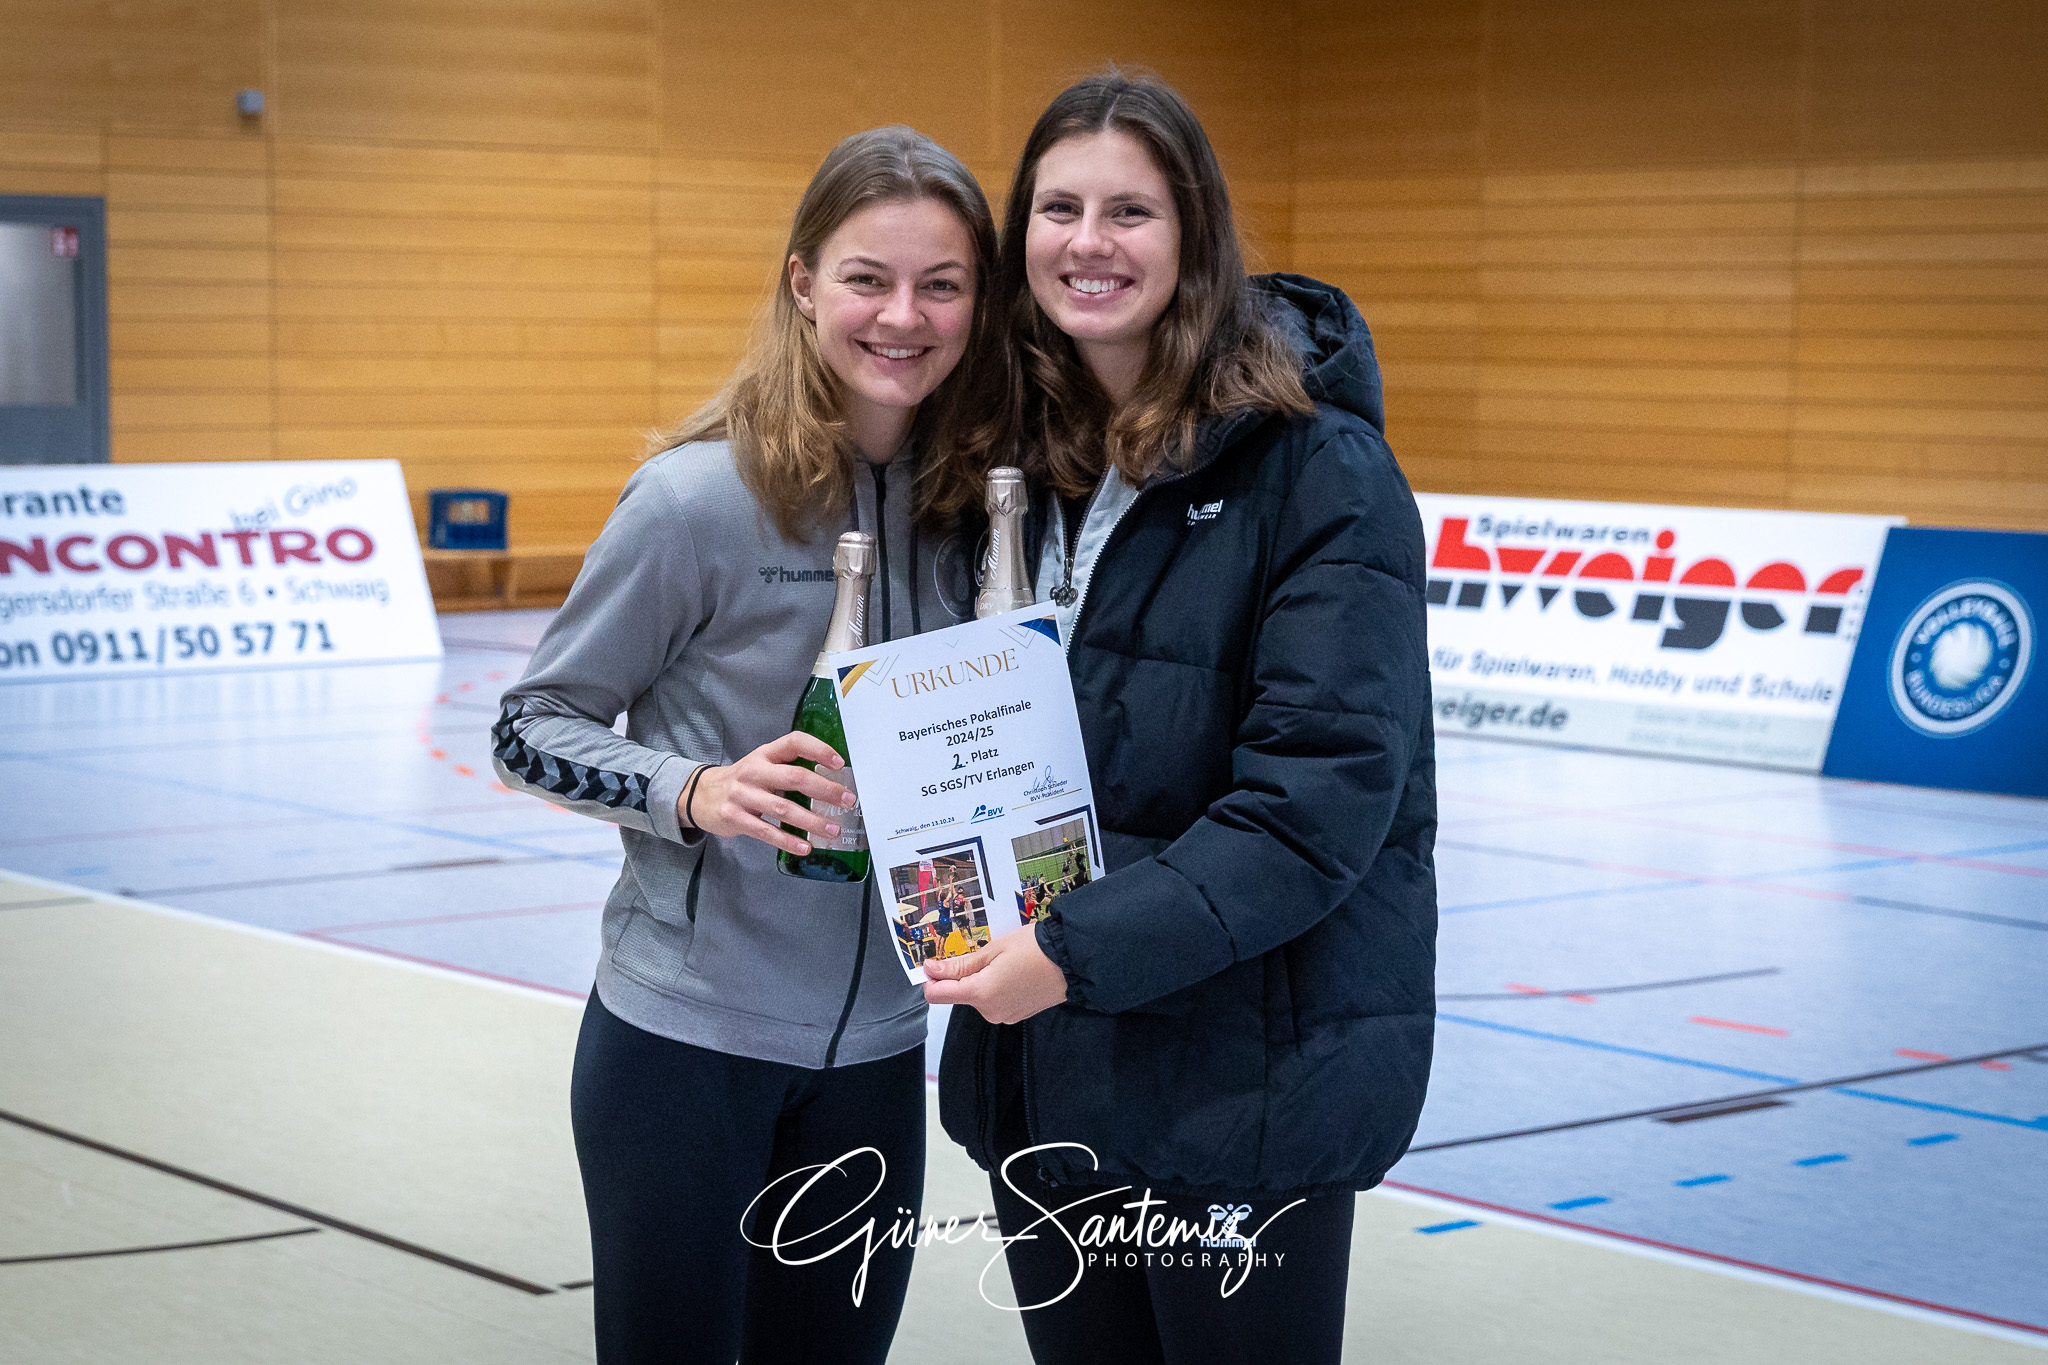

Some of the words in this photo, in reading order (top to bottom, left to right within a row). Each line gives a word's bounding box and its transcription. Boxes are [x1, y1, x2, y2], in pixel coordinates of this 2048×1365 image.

[284, 475, 358, 517] Gino
[1187, 499, 1223, 521] humel
[1475, 512, 1651, 546] Spielwaren
[987, 528, 1001, 581] Mumm
[144, 578, 231, 609] Straße
[238, 578, 257, 603] 6
[287, 574, 391, 606] Schwaig
[780, 566, 836, 583] humme
[848, 593, 865, 648] Mumm
[979, 601, 993, 611] DRY
[51, 625, 220, 669] 0911/50
[232, 622, 276, 654] 57
[291, 620, 336, 652] 71
[892, 648, 1020, 699] URKUNDE
[1609, 662, 1685, 698] Hobby
[1693, 672, 1742, 699] und
[1746, 673, 1835, 705] Schule
[898, 716, 969, 743] Bayerisches
[970, 699, 1033, 726] Pokalfinale
[945, 726, 995, 748] 2024/25
[971, 748, 999, 763] Platz
[921, 784, 938, 798] SG
[940, 772, 984, 793] SGS/TV
[986, 759, 1036, 782] Erlangen
[919, 822, 931, 830] den
[931, 816, 955, 827] 13.10.24
[987, 806, 1004, 817] BVV
[841, 837, 857, 845] DRY
